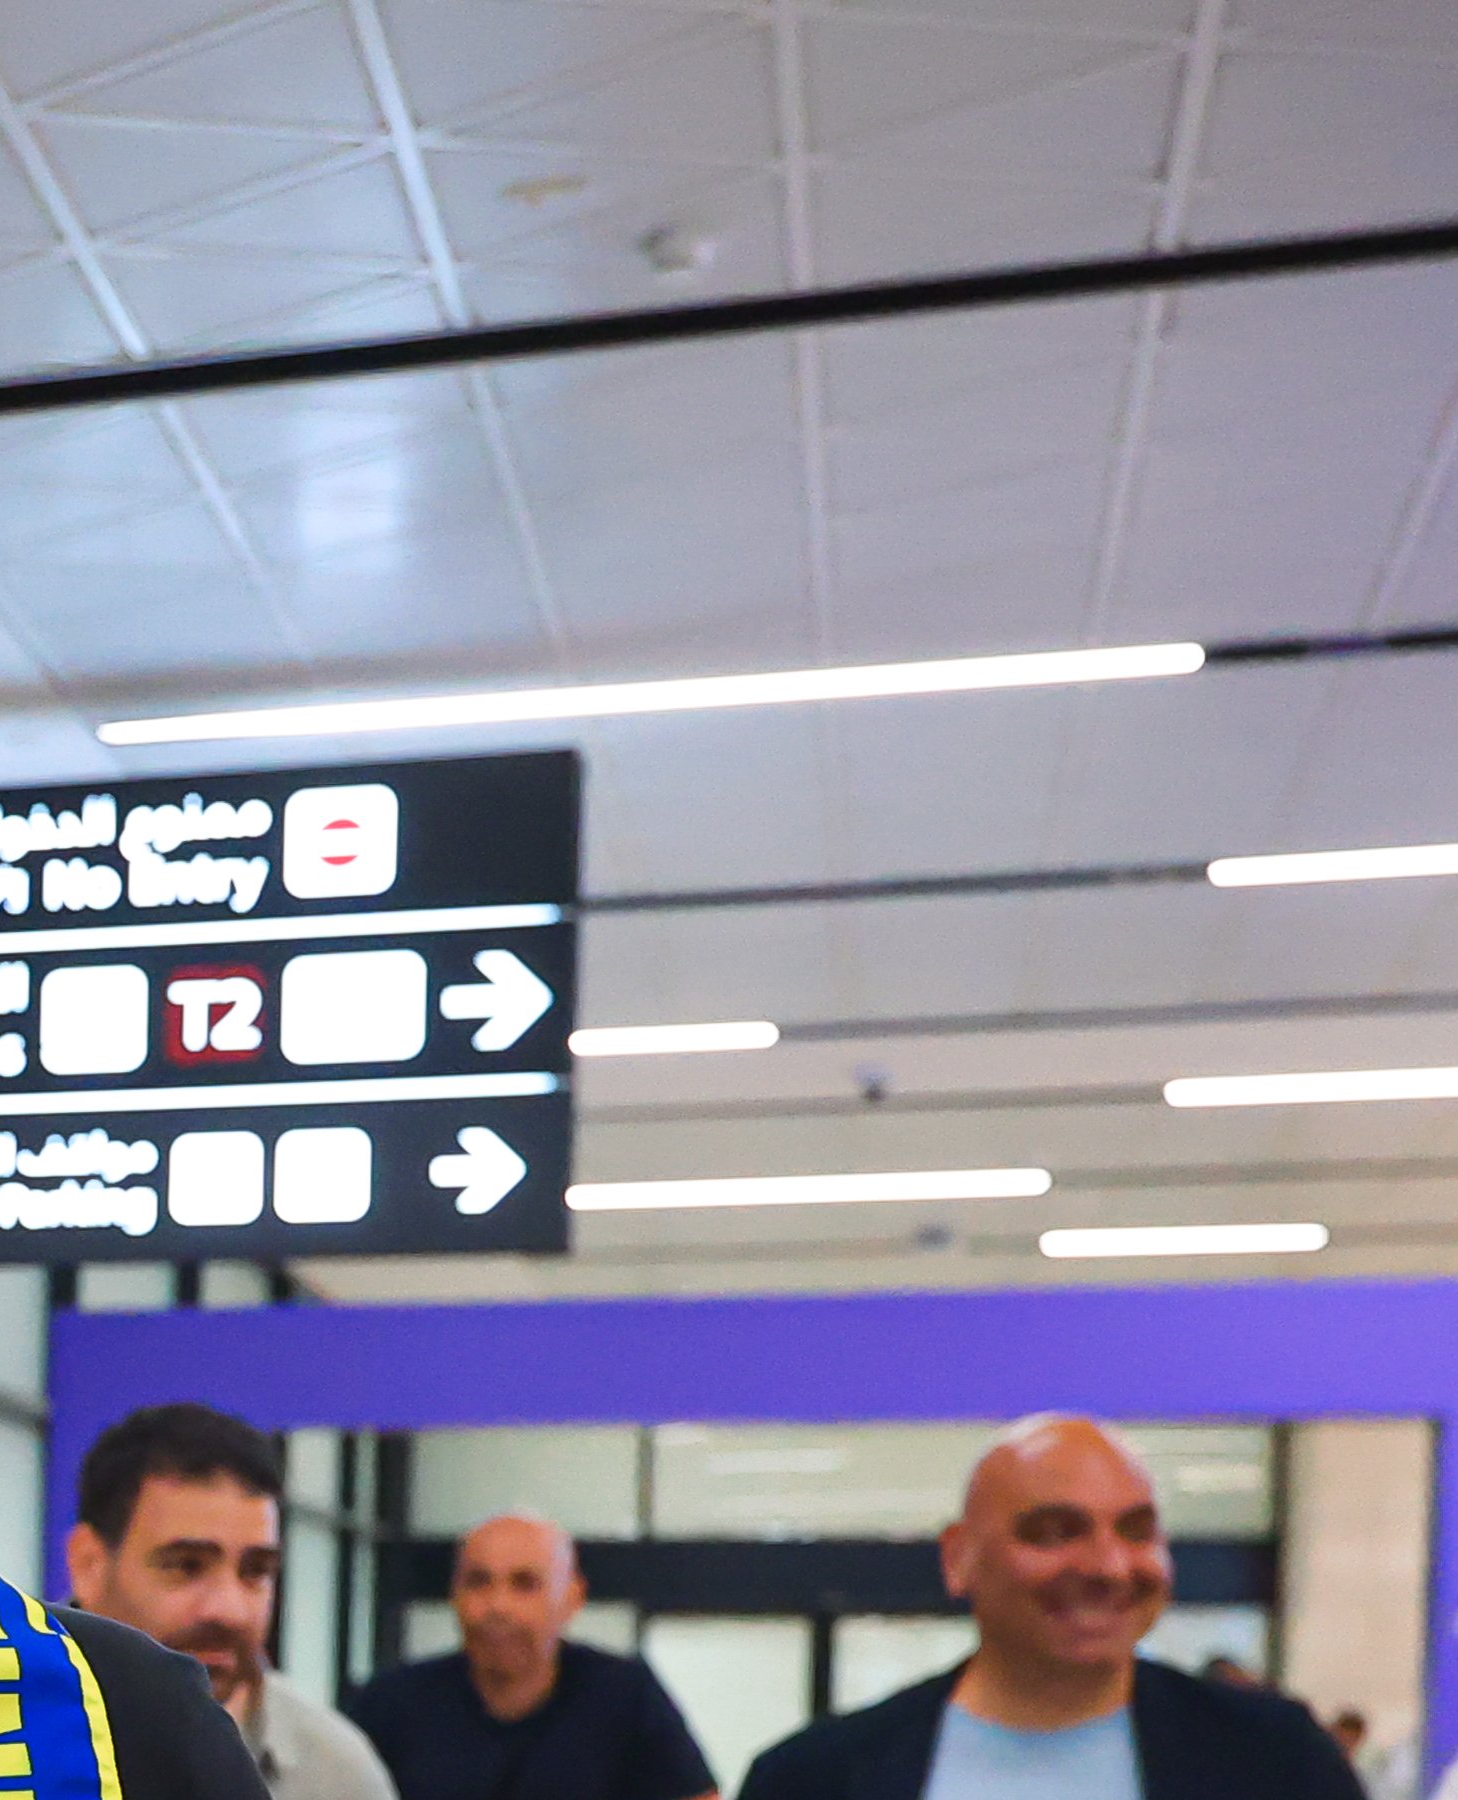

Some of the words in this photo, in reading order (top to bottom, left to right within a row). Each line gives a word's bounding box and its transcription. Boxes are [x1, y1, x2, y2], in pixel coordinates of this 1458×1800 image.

[42, 857, 124, 912] No
[128, 853, 271, 915] Entry
[166, 976, 264, 1054] T2
